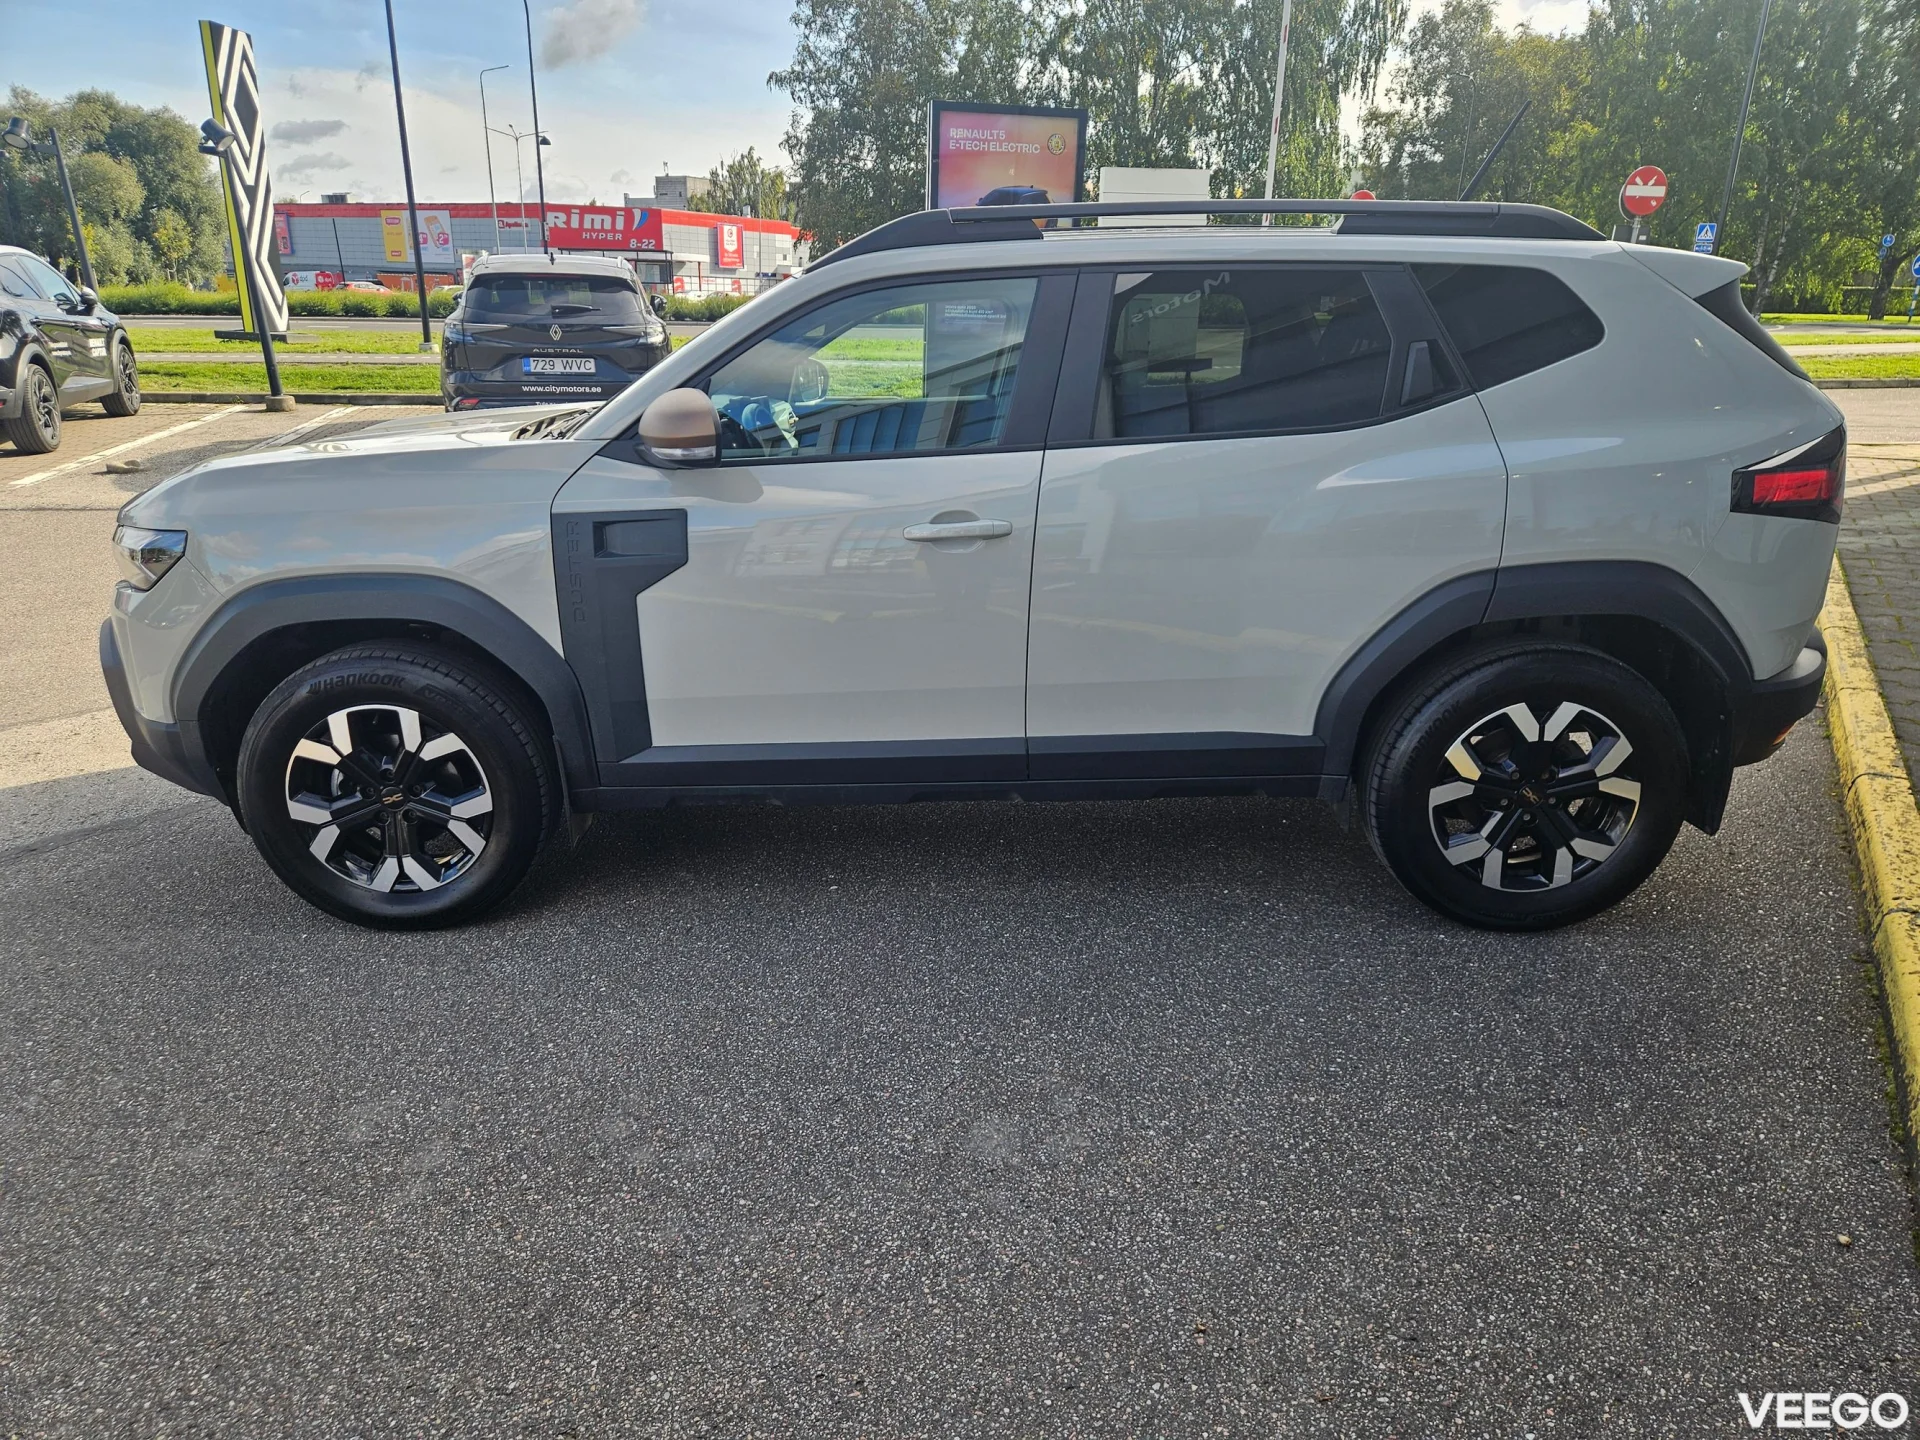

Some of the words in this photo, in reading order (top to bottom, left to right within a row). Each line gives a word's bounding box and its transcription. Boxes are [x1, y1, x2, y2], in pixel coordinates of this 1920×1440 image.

[950, 128, 999, 140] RENAULT
[949, 140, 988, 151] E-TECH
[989, 142, 1041, 153] ELECTRIC
[546, 208, 625, 231] Rimi
[582, 231, 623, 241] HYPER
[630, 239, 656, 249] 8-22
[532, 359, 555, 371] 729
[561, 359, 592, 371] WVC
[522, 385, 602, 395] www.citymotors.ee
[566, 521, 586, 623] DUSTER
